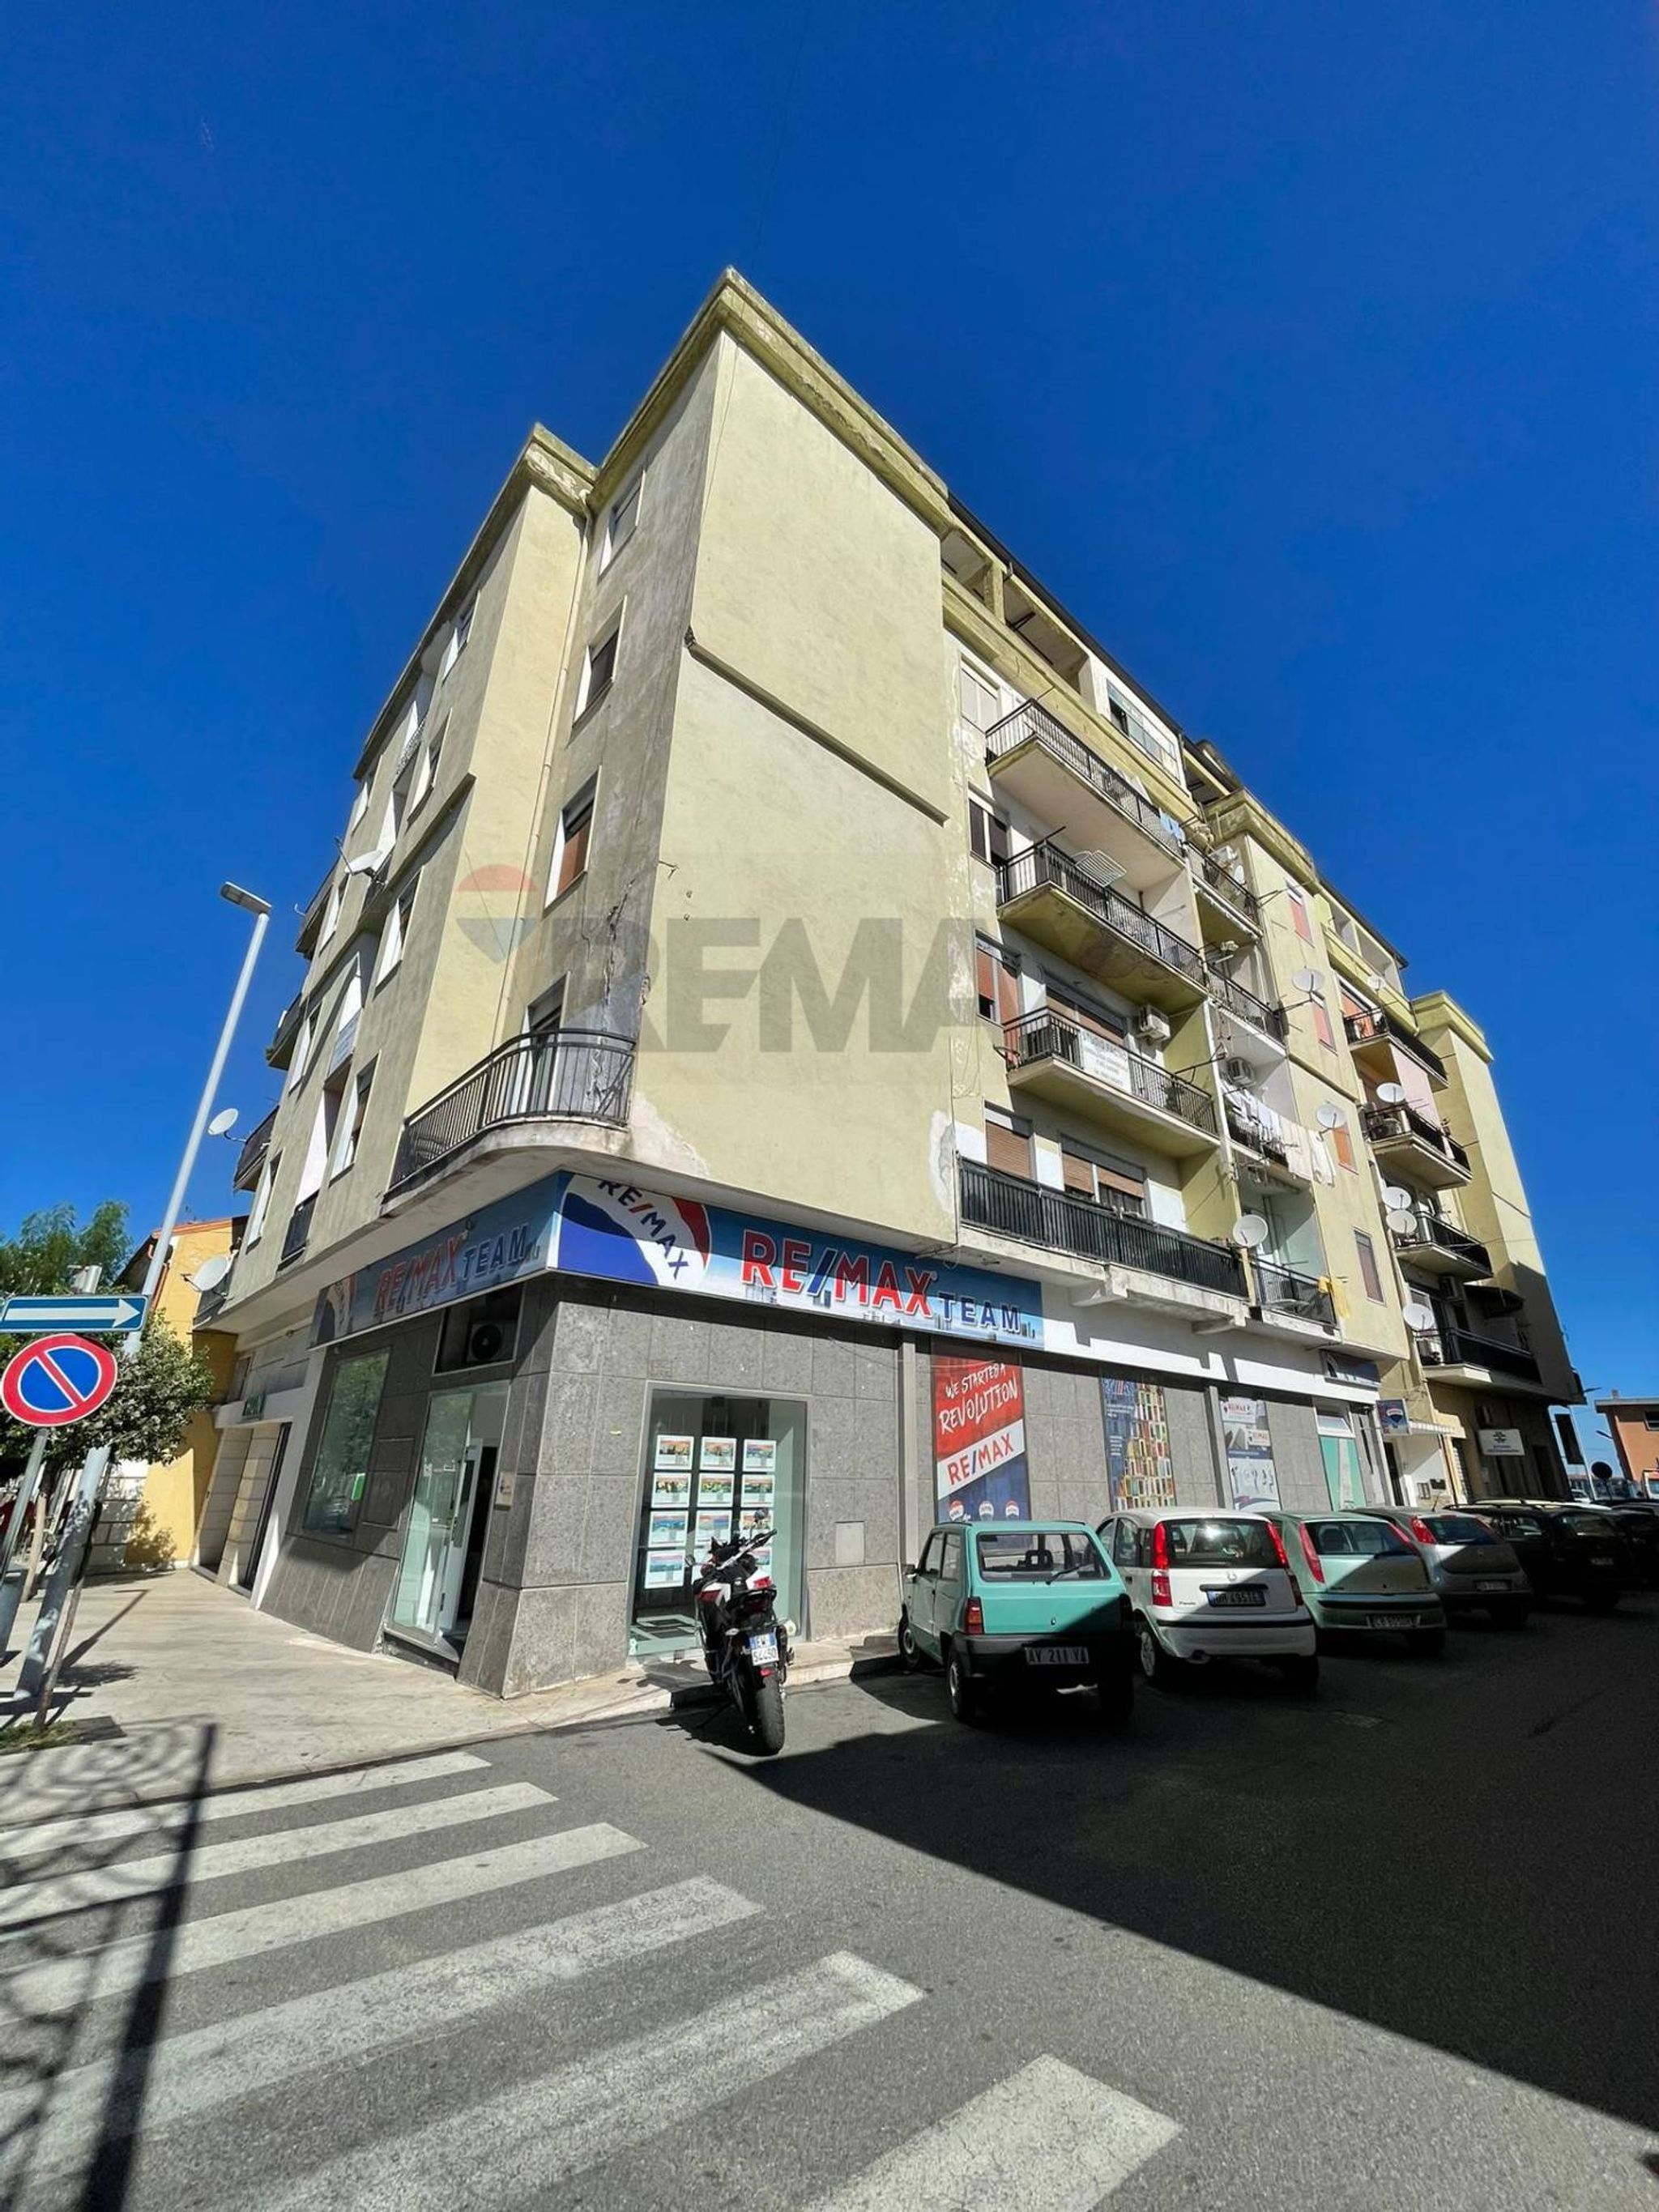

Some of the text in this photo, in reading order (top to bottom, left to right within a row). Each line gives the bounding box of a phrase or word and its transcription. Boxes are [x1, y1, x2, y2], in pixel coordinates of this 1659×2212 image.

[462, 1222, 529, 1282] TEAM
[740, 1230, 1022, 1333] RE/MAX TEAM
[940, 1370, 1017, 1435] REVOLUTION
[945, 1379, 959, 1400] WE
[962, 1363, 1000, 1393] STARTED
[947, 1433, 1014, 1485] RE/MAX
